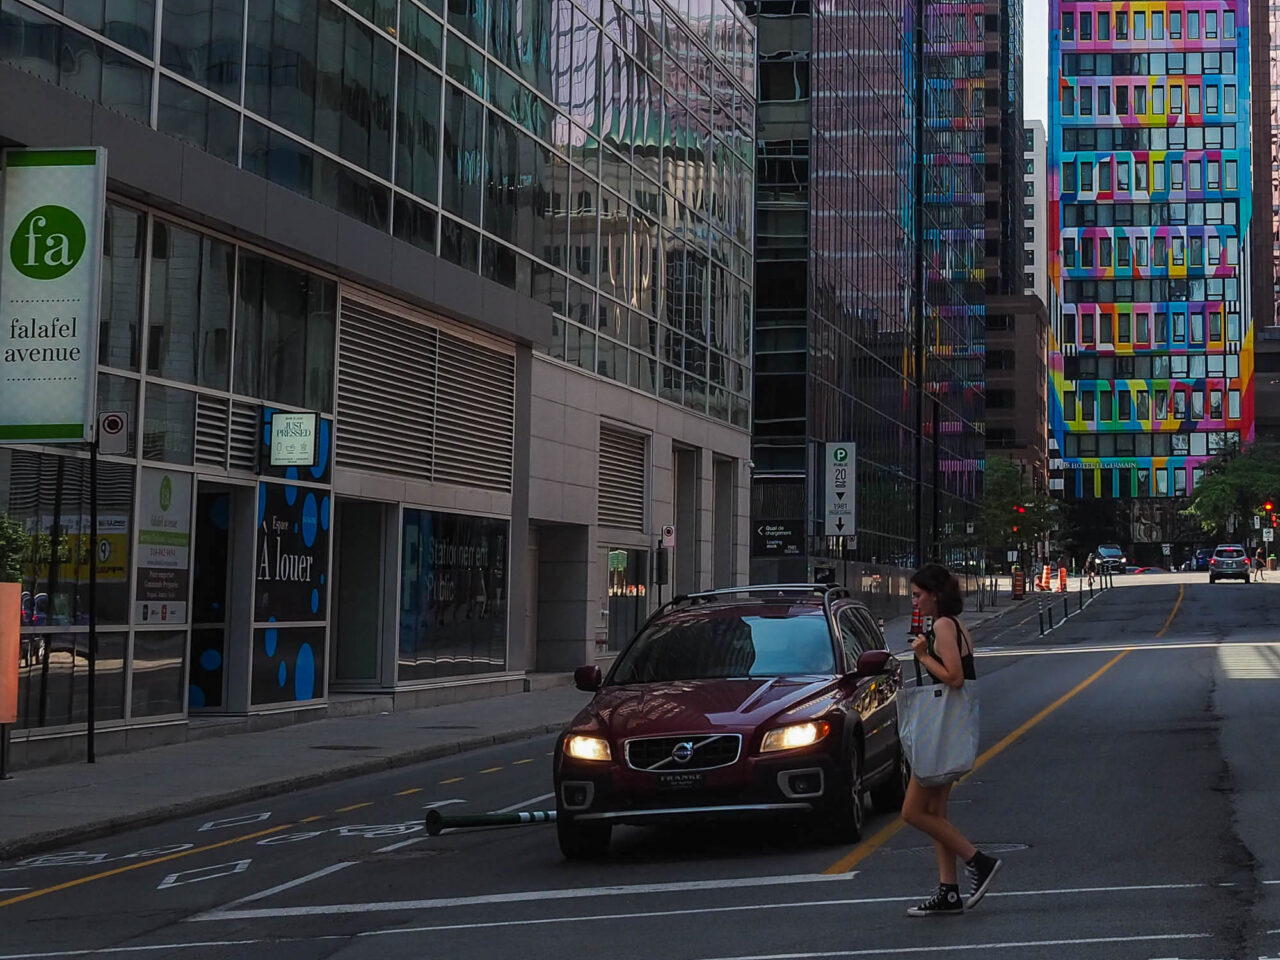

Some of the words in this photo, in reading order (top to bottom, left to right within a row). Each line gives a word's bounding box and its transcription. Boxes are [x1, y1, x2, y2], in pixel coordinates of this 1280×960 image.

[23, 215, 74, 266] fa
[9, 316, 77, 339] falafel
[4, 346, 81, 363] avenue
[276, 429, 312, 438] PRESSED
[835, 468, 847, 480] 20
[257, 520, 271, 581] À
[275, 536, 314, 582] louer
